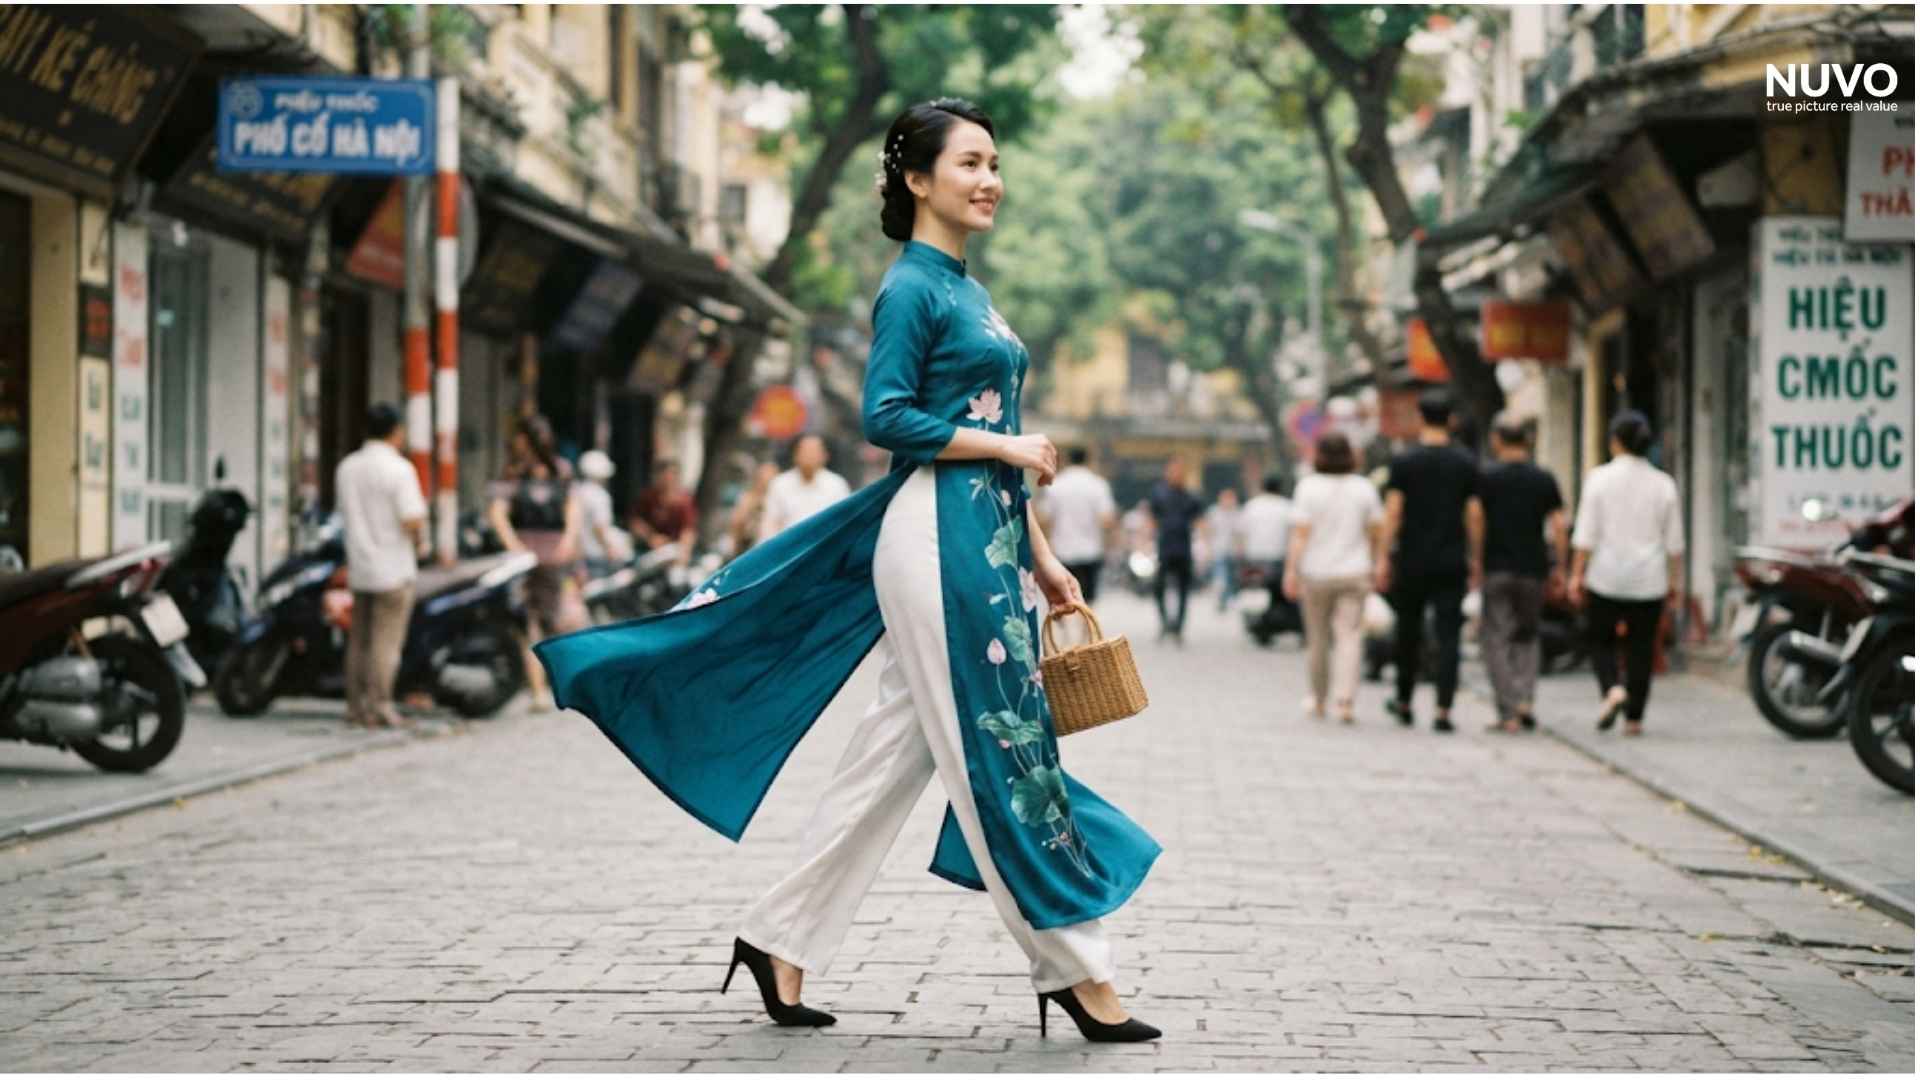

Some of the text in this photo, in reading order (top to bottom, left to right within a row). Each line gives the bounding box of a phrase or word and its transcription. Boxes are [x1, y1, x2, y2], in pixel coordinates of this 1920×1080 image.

[234, 109, 420, 167] PHỐ CỐ HÀ NỘI
[1788, 276, 1886, 342] HIỆU
[1777, 338, 1897, 400] CMỐC
[1770, 407, 1903, 469] THUỐC
